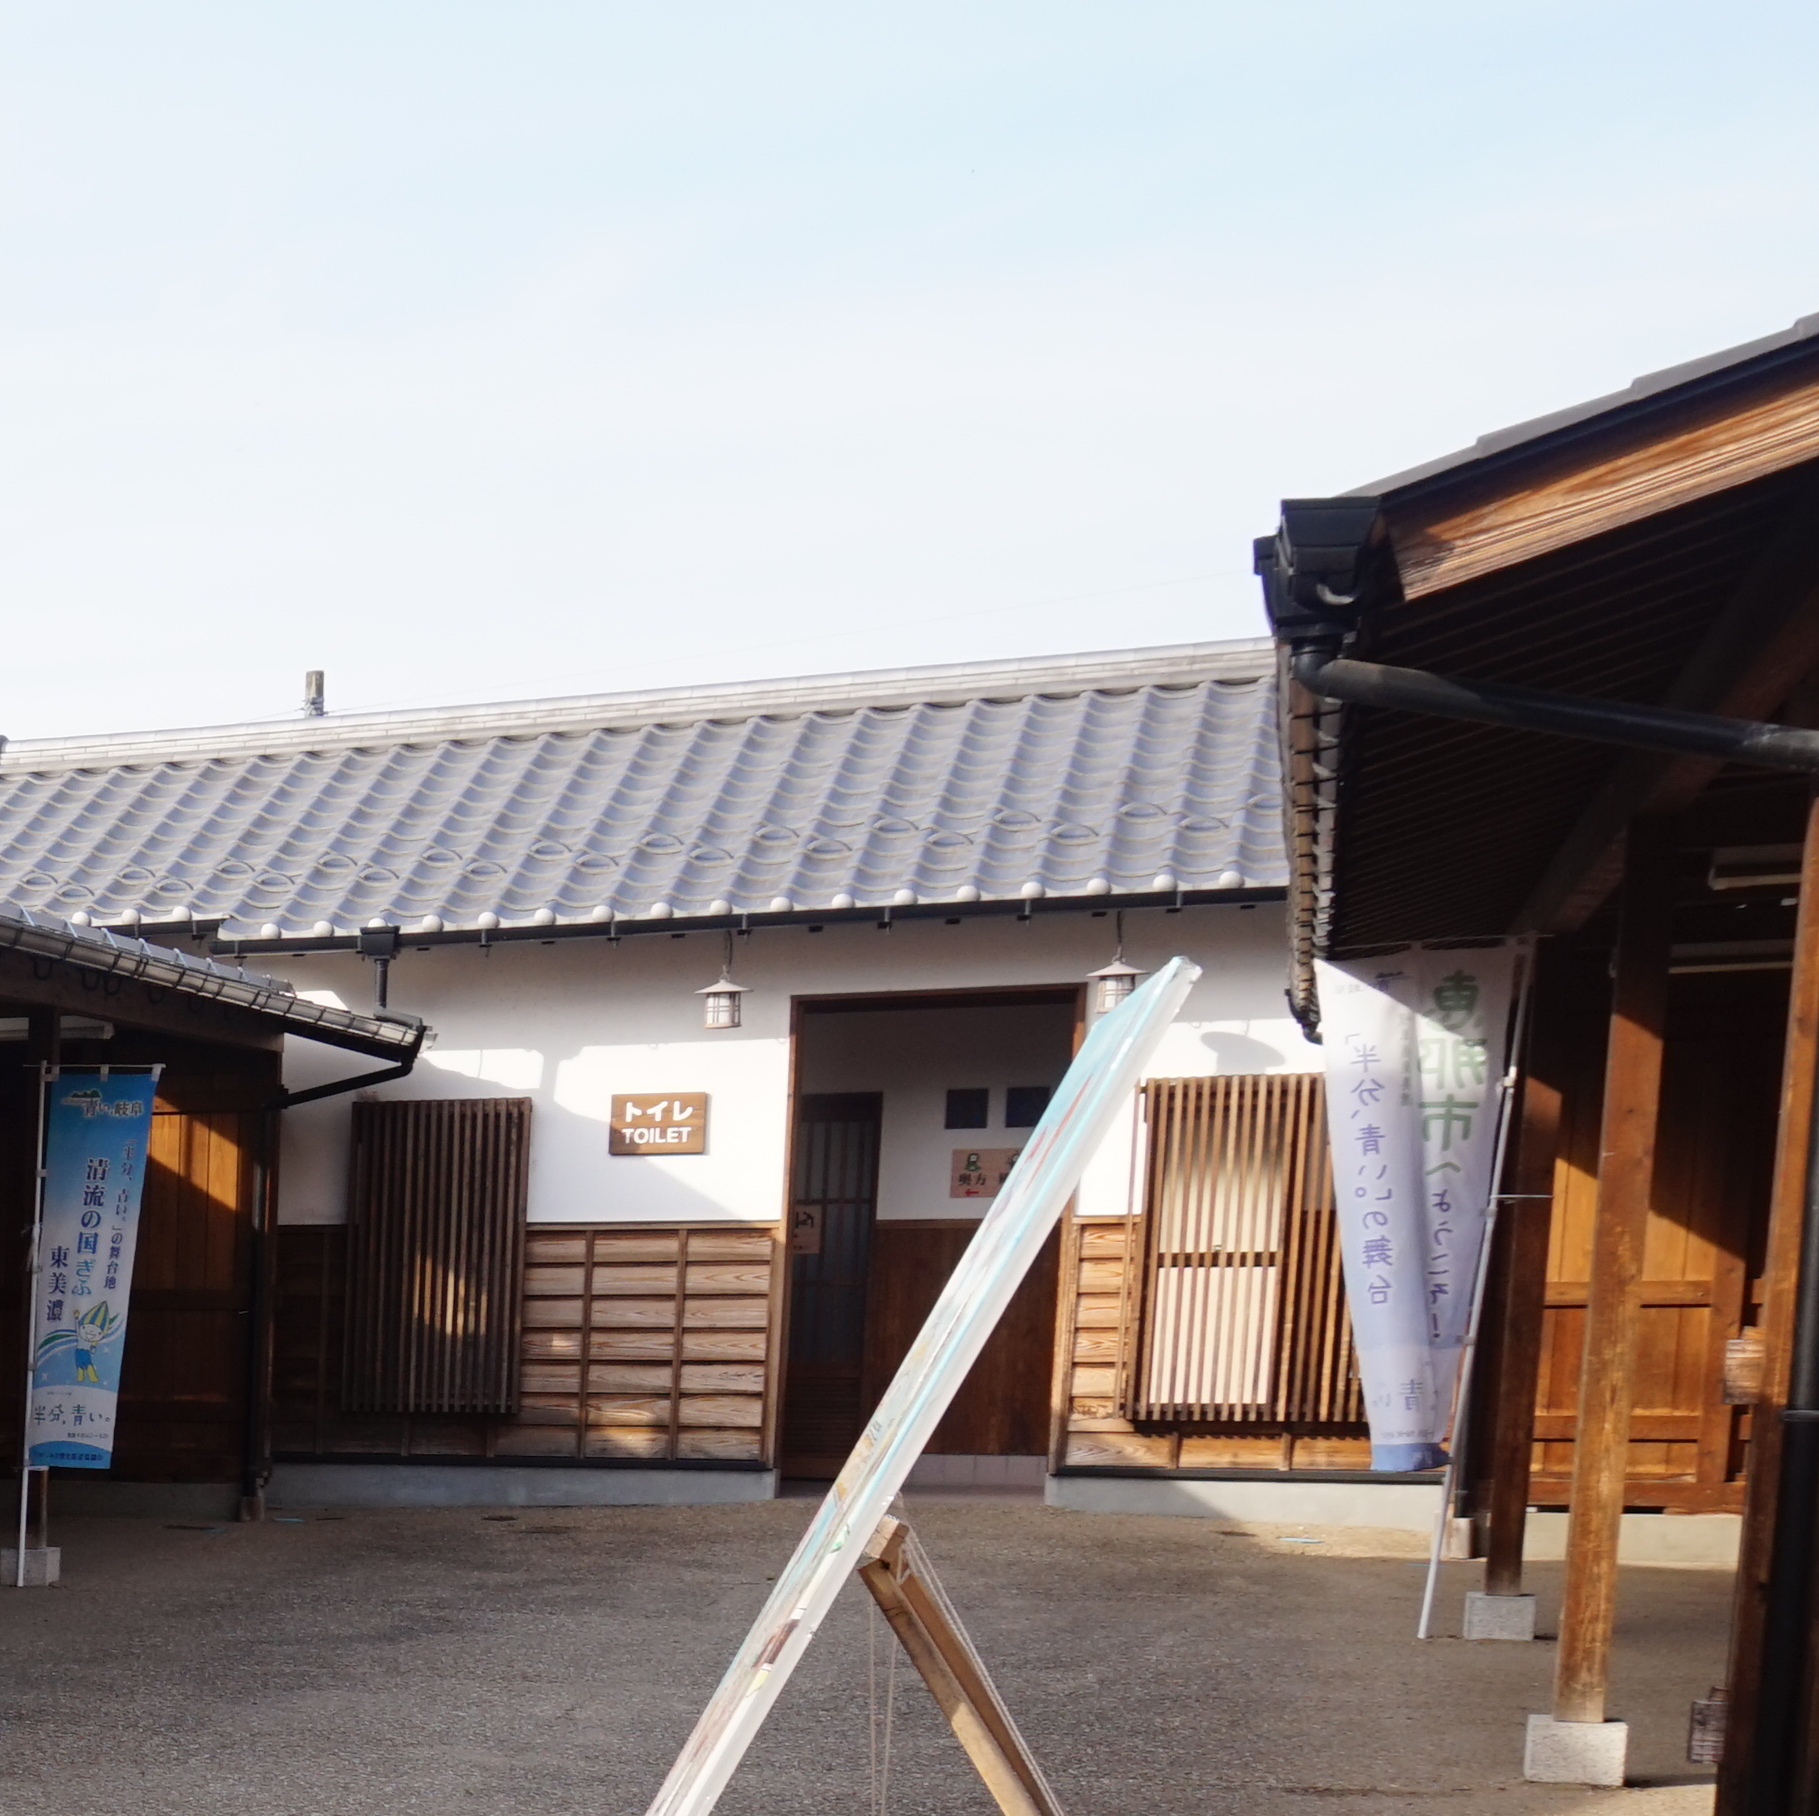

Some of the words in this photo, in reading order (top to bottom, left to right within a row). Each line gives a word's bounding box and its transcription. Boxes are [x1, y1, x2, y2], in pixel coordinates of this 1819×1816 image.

[625, 1100, 694, 1123] トイレ
[621, 1126, 692, 1144] TOILET
[71, 1157, 109, 1297] 清流の国ぎふ
[46, 1245, 69, 1322] 東美濃
[34, 1403, 111, 1427] 半分、青い。
